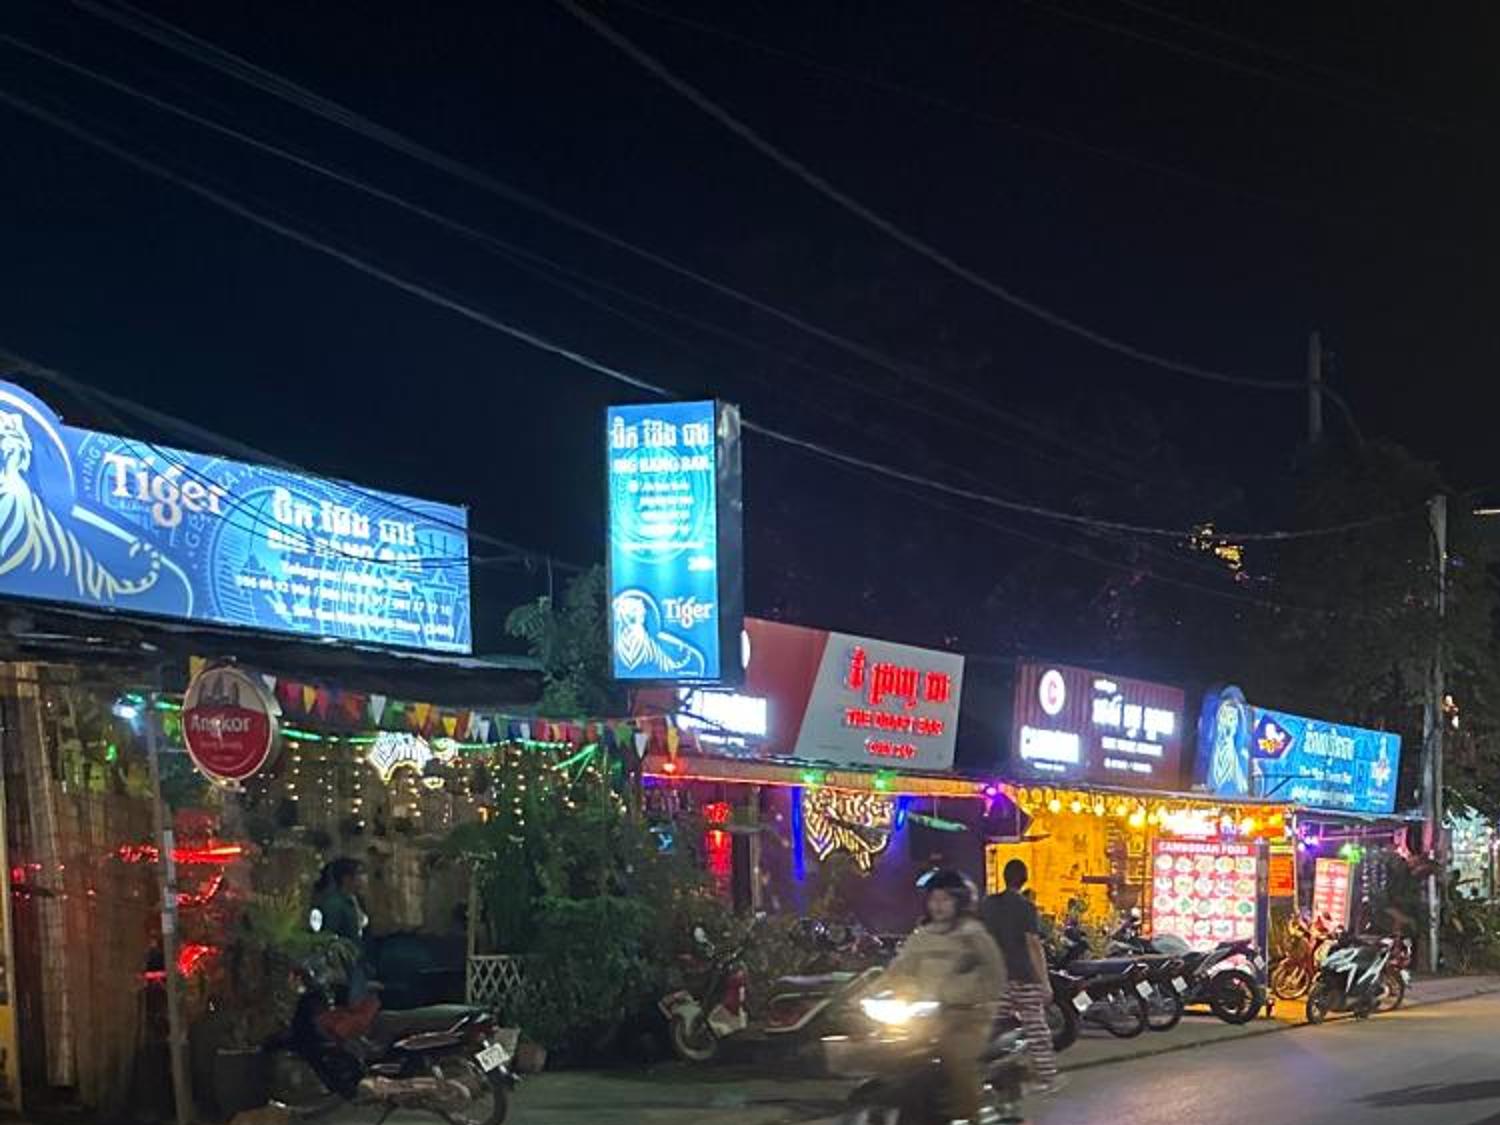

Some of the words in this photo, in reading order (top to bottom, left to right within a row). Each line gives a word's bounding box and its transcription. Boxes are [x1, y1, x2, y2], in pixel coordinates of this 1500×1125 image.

[103, 451, 227, 528] Tiger
[661, 596, 714, 629] Tiger
[191, 714, 253, 737] Angkor
[845, 708, 871, 727] THE
[916, 718, 944, 737] BAR
